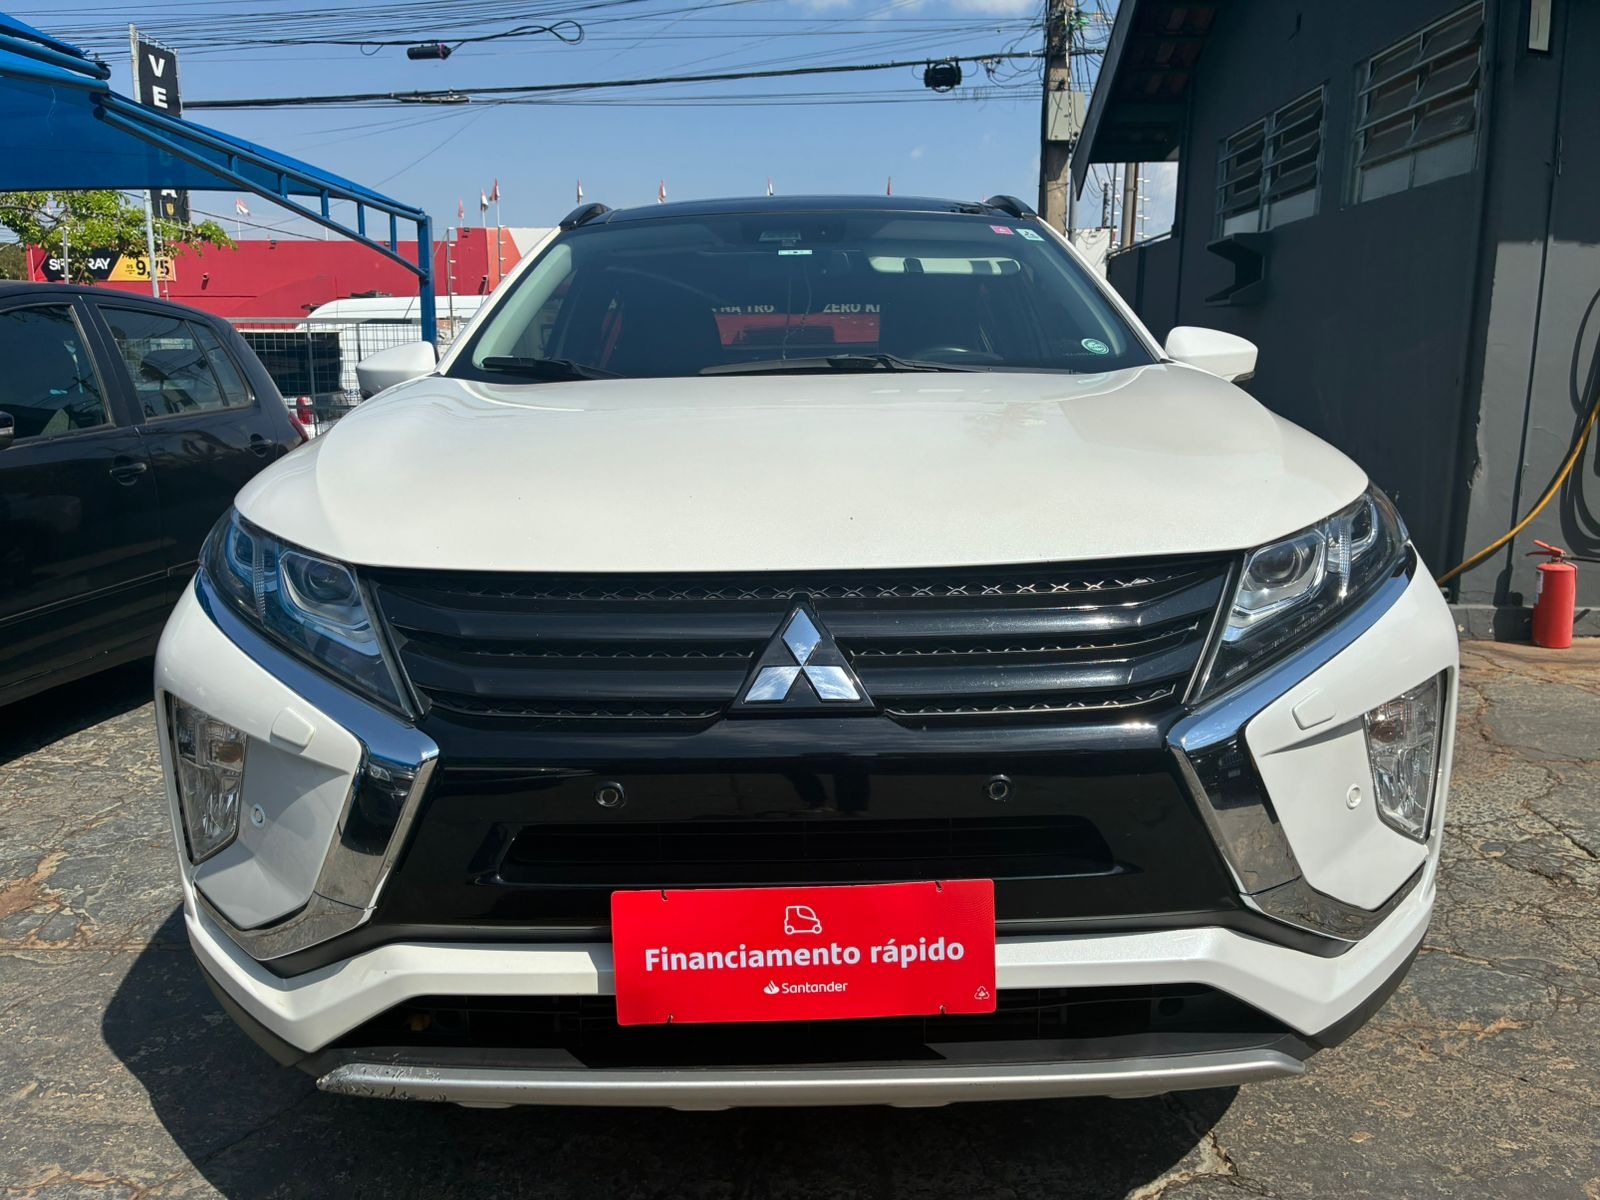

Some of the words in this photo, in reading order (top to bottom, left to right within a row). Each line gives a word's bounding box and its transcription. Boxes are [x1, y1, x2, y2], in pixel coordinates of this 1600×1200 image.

[644, 942, 861, 972] Financiamento
[870, 937, 965, 968] rápido
[781, 980, 848, 994] Santander
